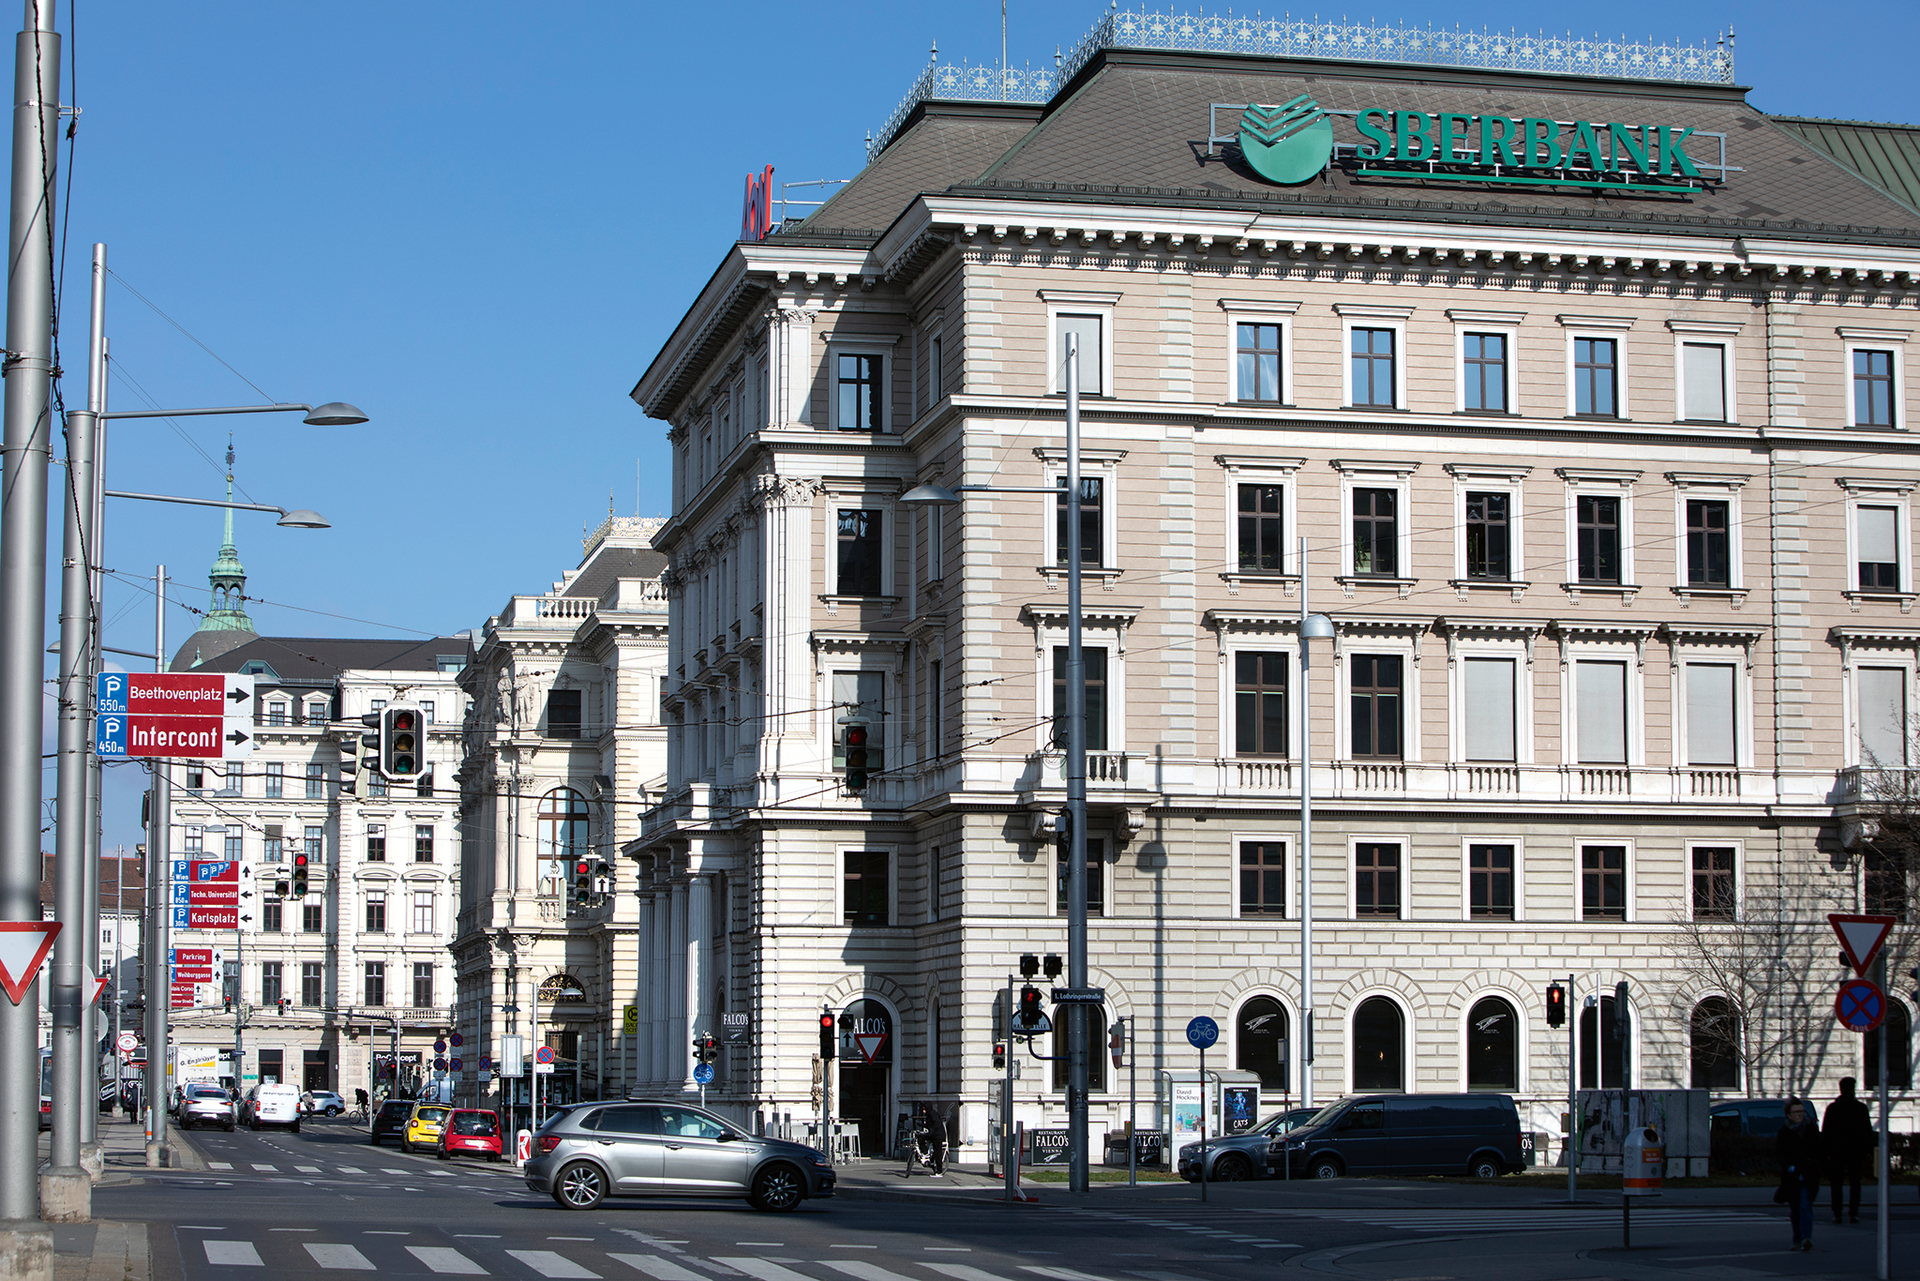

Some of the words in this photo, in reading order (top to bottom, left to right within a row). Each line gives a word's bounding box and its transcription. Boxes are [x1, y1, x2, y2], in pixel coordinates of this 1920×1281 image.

[1356, 108, 1702, 177] SBERBANK
[130, 686, 222, 702] Beethovenplatz
[132, 725, 217, 747] Intercont
[192, 913, 236, 925] Karlsplatz
[182, 953, 206, 962] Parkring
[724, 1014, 748, 1025] FALCO's
[854, 1018, 886, 1034] ALCO's
[376, 1054, 416, 1062] BoCcept
[1233, 1119, 1248, 1128] CATS
[1036, 1135, 1069, 1146] FALCO's
